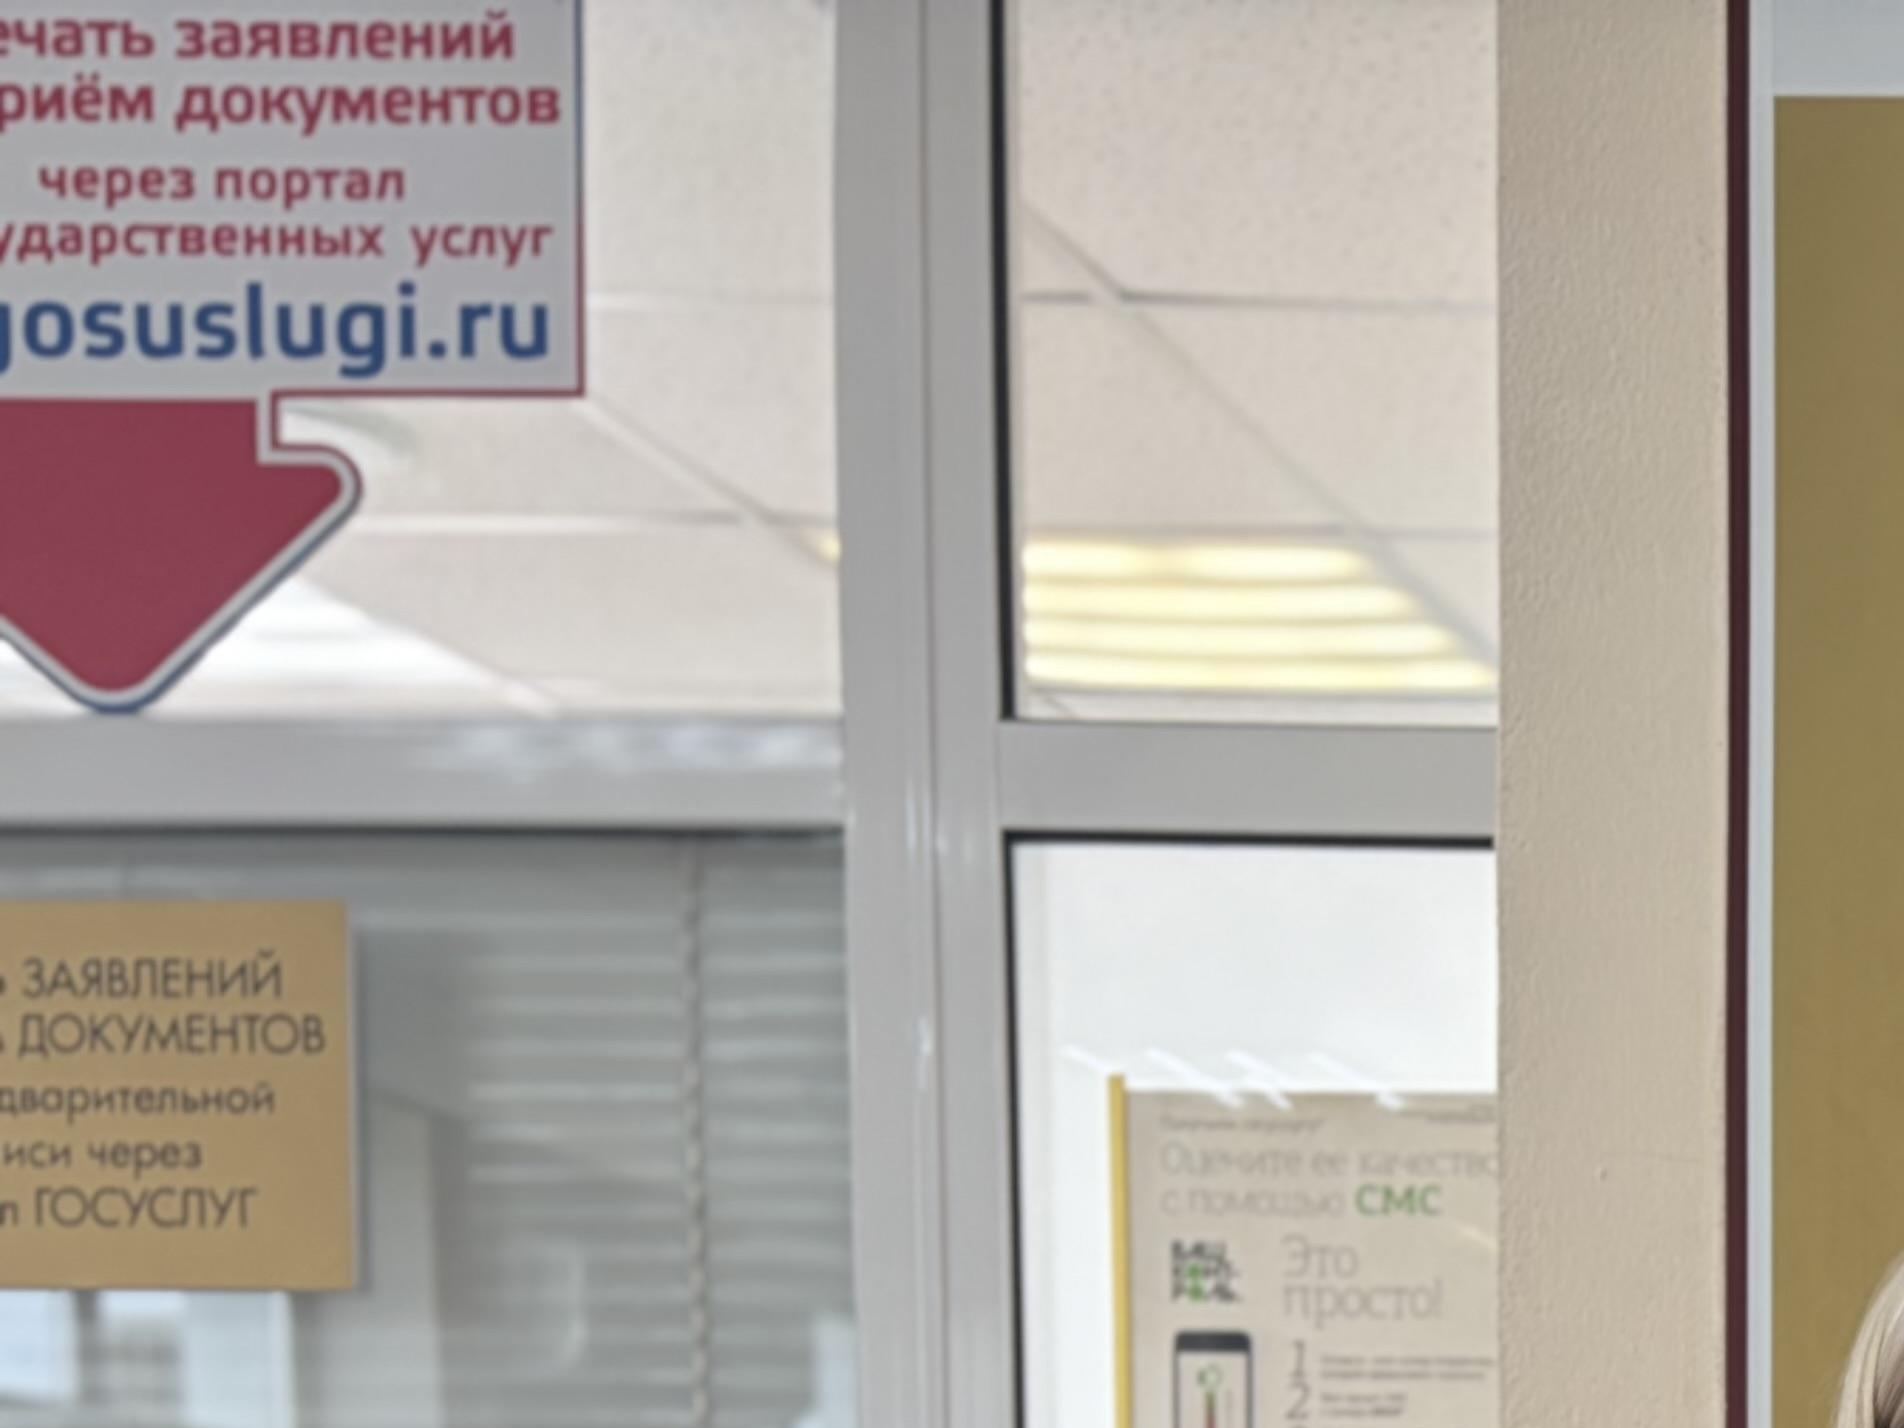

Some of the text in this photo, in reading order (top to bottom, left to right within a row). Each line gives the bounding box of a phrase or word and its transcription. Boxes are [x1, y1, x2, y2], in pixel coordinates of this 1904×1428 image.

[174, 11, 514, 60] заявлений
[173, 84, 560, 136] документов
[38, 166, 406, 210] через портал
[411, 223, 555, 268] услуг
[0, 281, 550, 379] osuslugi.ru
[22, 949, 283, 999] ЗАЯВЛЕНИЙ
[18, 1013, 326, 1059] ДОКУМЕНТОВ
[87, 1141, 203, 1180] через
[35, 1186, 260, 1229] ГОСУСЛУГ
[1354, 1183, 1441, 1216] СМС
[1281, 1233, 1359, 1279] Это
